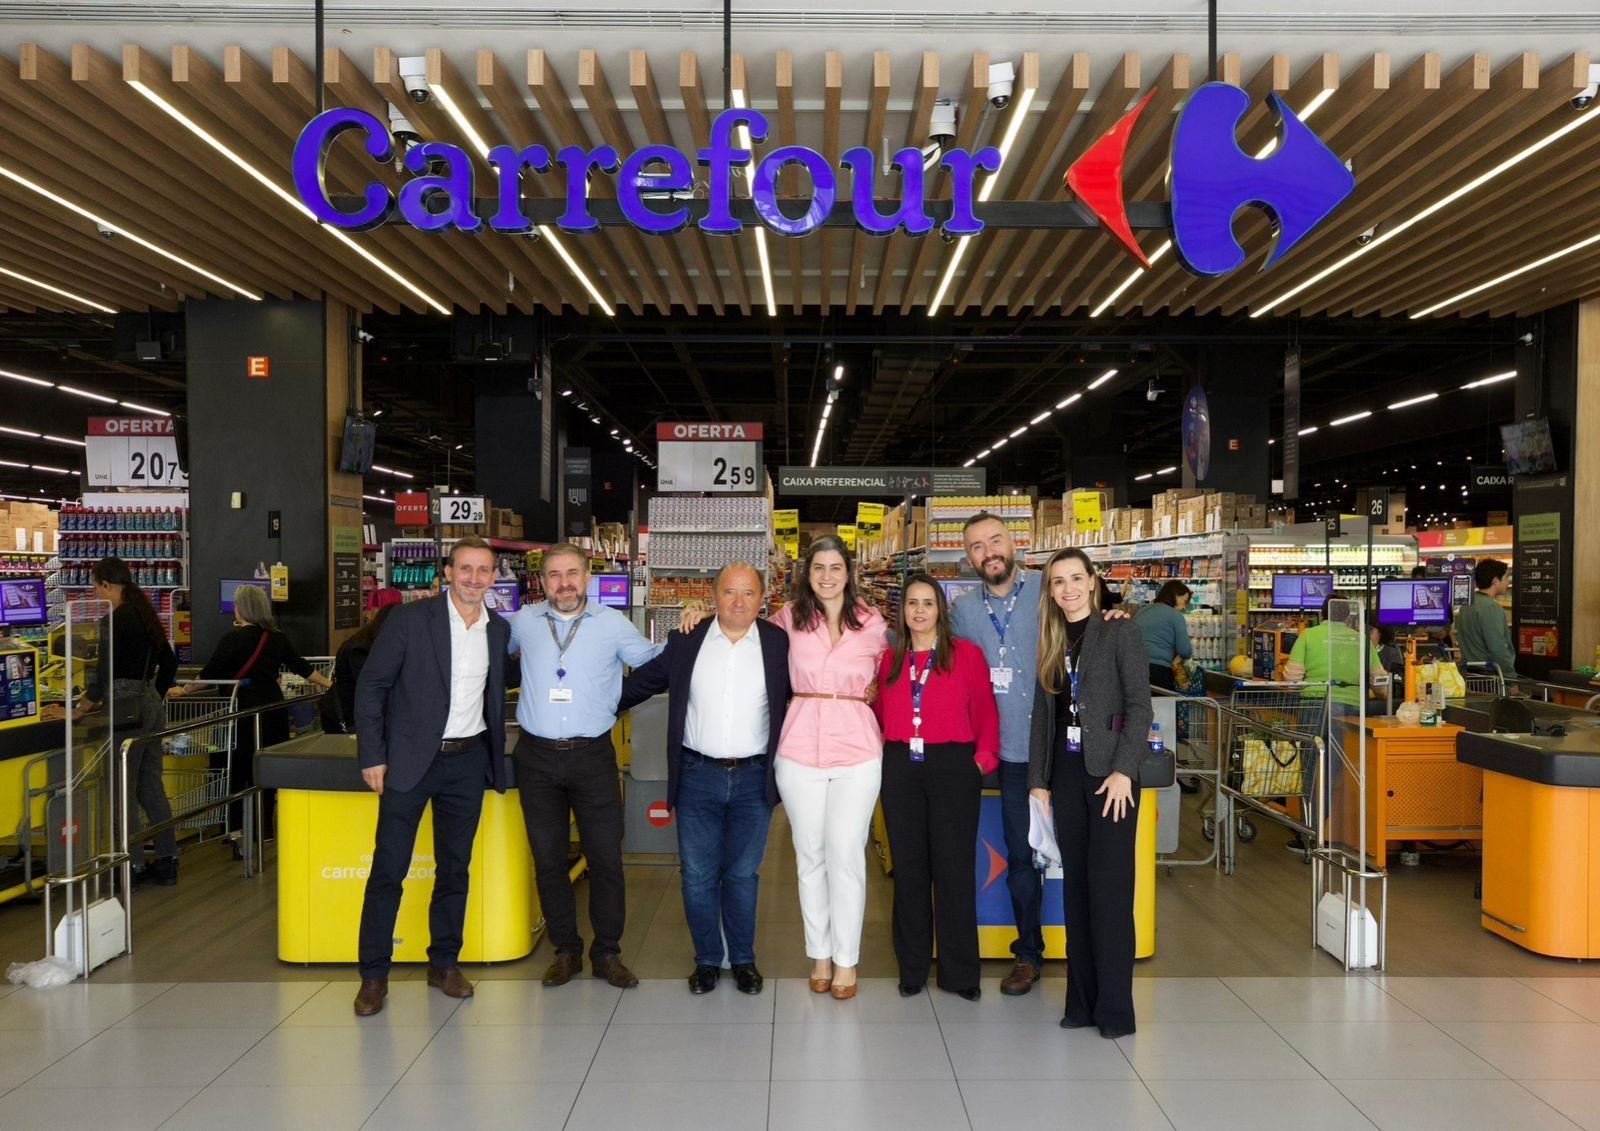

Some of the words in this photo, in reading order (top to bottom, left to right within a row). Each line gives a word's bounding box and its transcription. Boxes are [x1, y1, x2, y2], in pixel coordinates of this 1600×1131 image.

[291, 107, 1002, 236] Carrefour
[251, 357, 265, 375] E
[105, 419, 174, 433] OFERTA
[673, 424, 746, 438] OFERTA
[1229, 439, 1239, 450] E
[783, 477, 813, 486] CAIXA
[814, 477, 886, 487] PREFERENCIAL
[1476, 475, 1506, 485] CAIXA
[450, 500, 471, 520] 29
[1371, 499, 1383, 515] 26
[1327, 518, 1336, 530] 25
